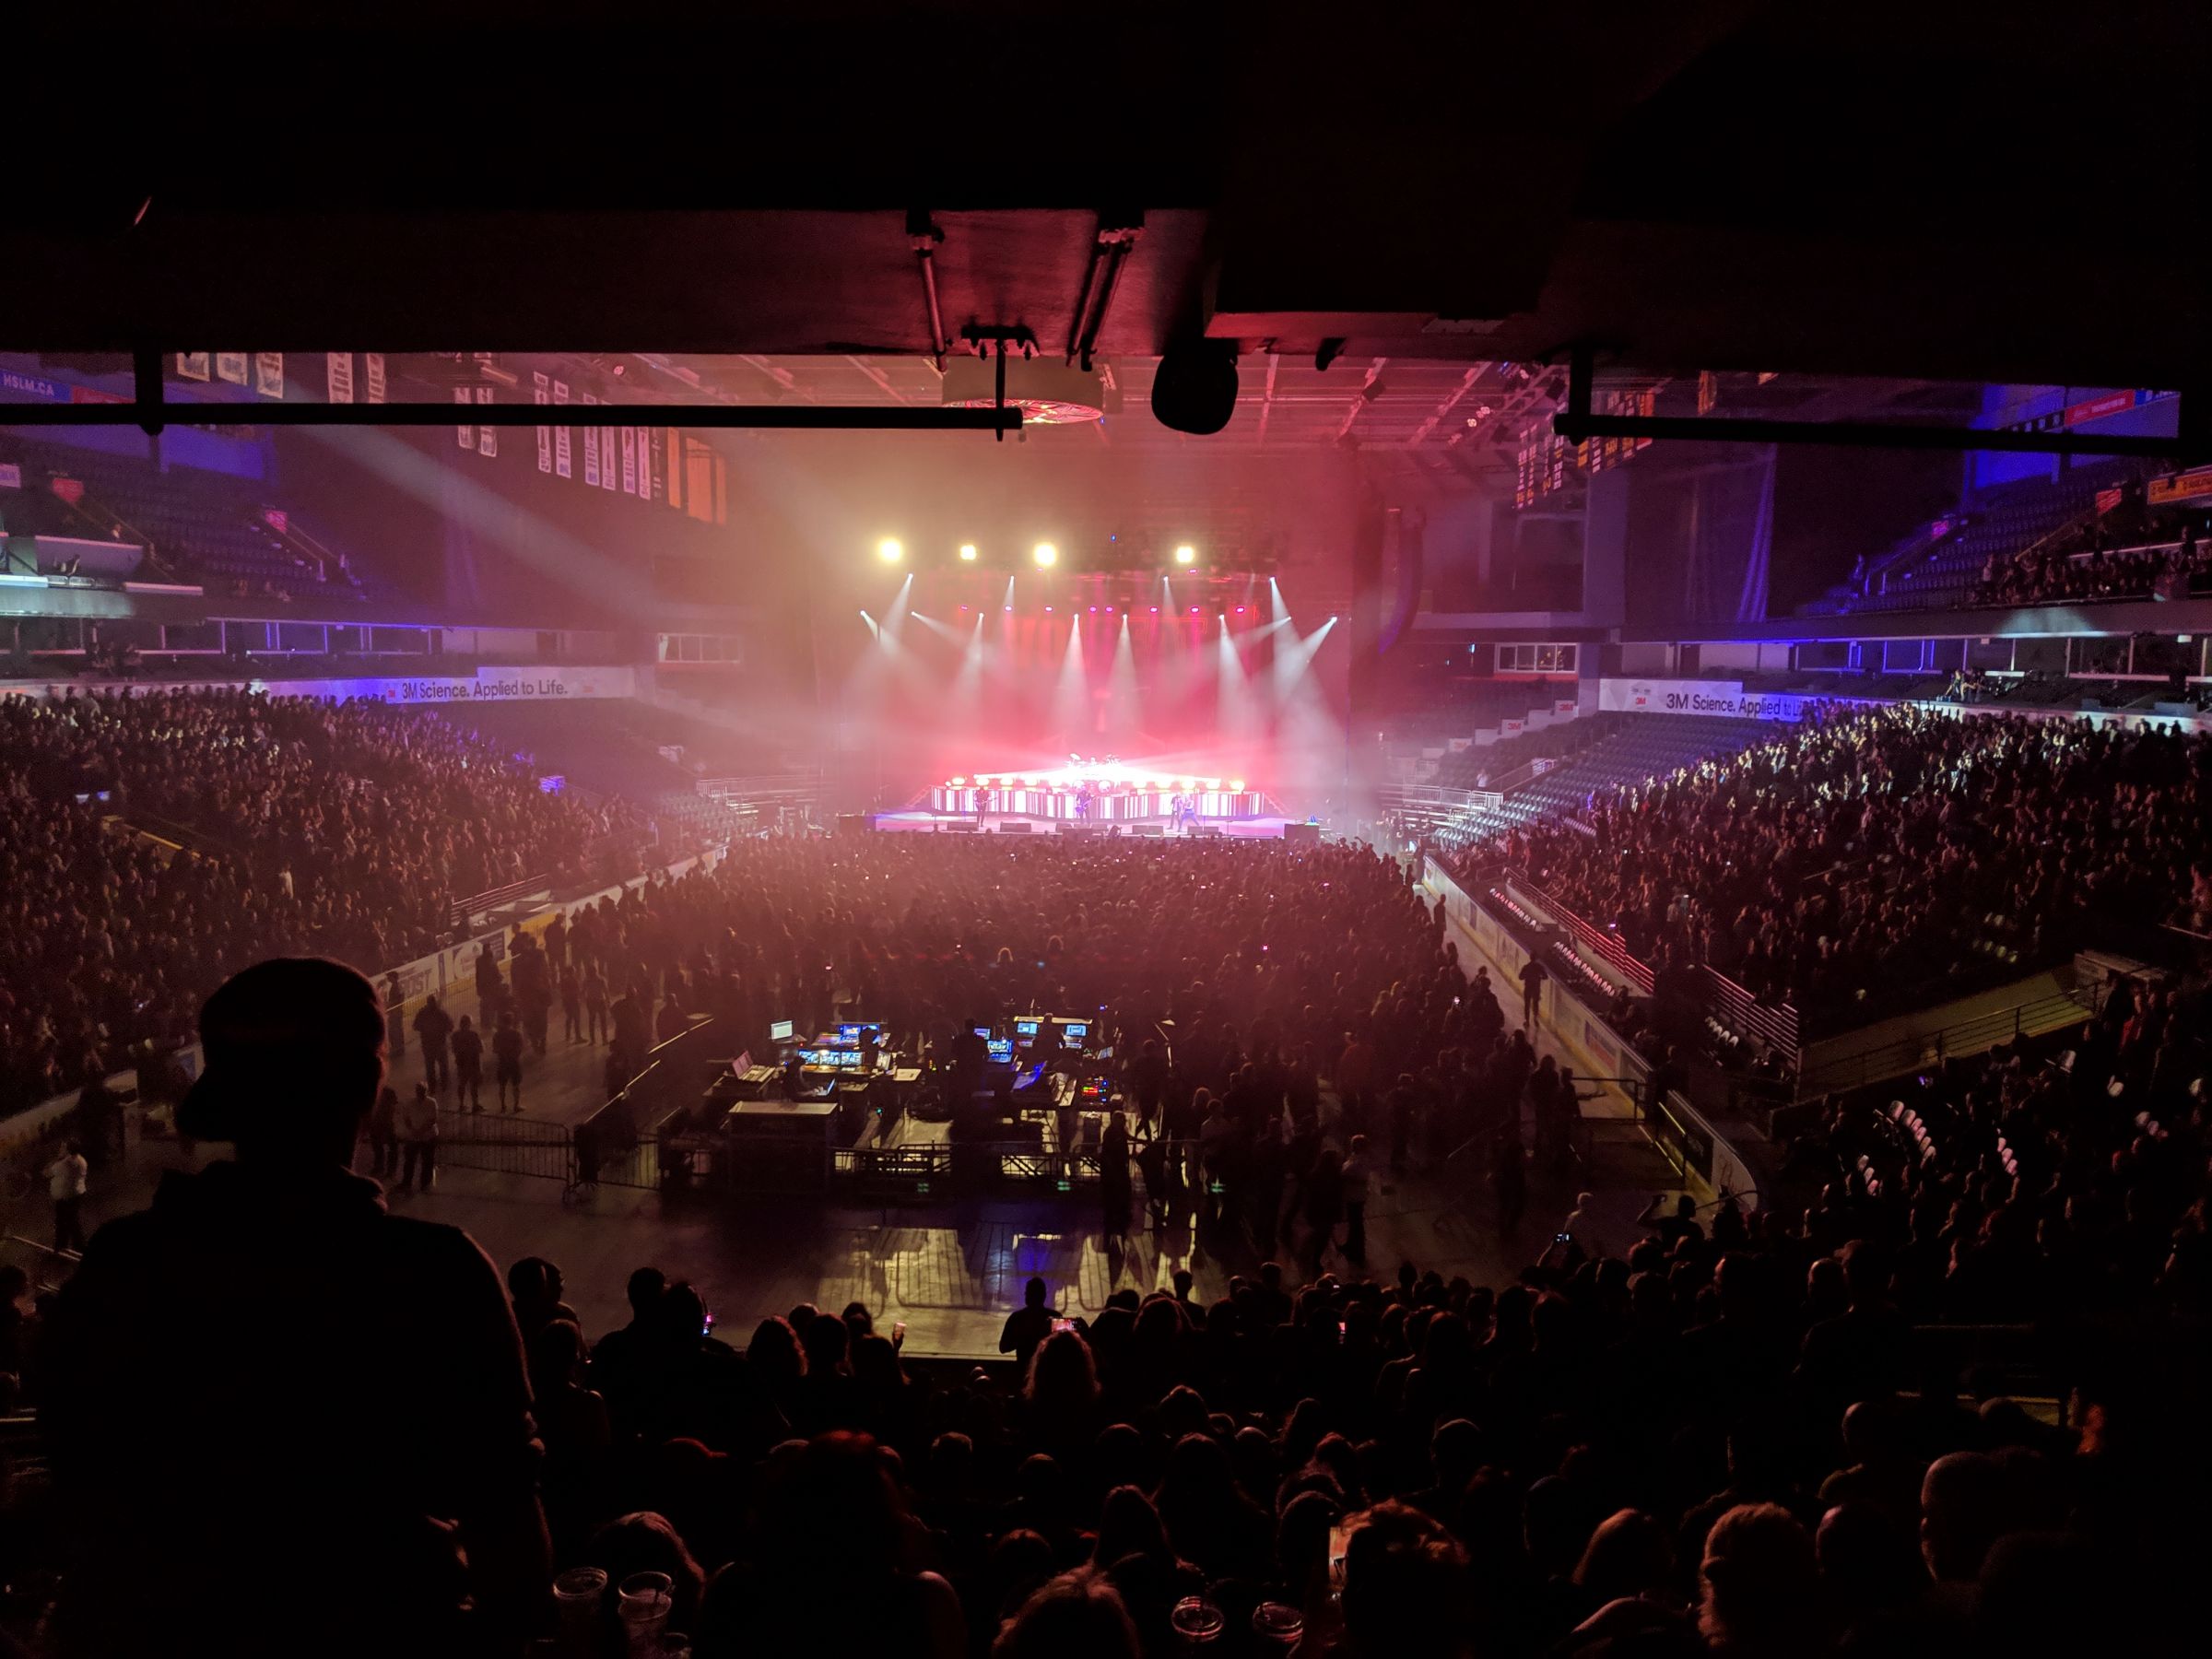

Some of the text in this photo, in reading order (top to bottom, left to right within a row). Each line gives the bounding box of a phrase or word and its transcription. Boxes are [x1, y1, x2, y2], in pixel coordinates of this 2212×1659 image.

[402, 682, 418, 699] 3M
[419, 682, 470, 698] Science.
[473, 679, 518, 700] Applied
[522, 681, 535, 696] to
[538, 679, 568, 695] Life.
[1665, 693, 1688, 710] 3M
[1692, 694, 1736, 712] Science.
[1738, 697, 1781, 717] Applied
